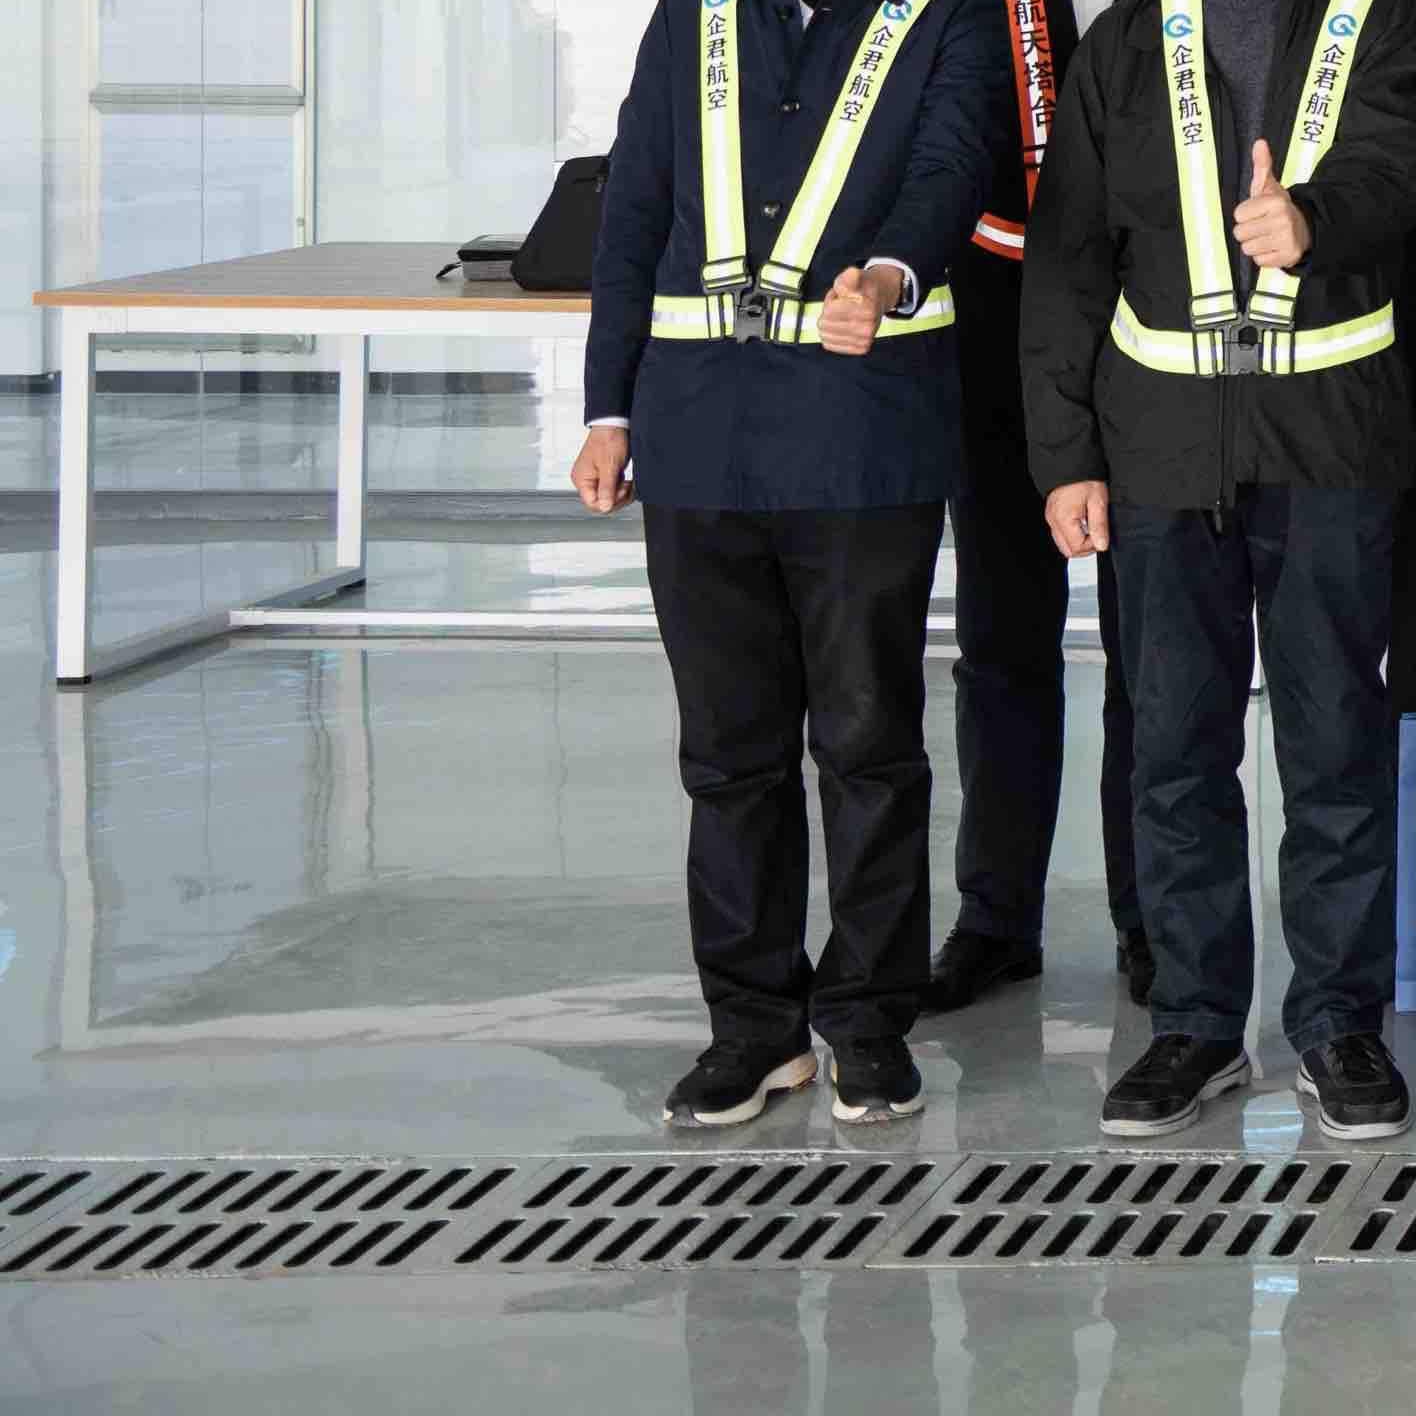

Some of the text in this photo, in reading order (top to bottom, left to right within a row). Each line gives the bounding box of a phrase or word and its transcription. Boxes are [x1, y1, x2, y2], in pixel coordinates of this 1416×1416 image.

[706, 14, 729, 111] 企君航空
[839, 25, 894, 123] 企君航空
[1171, 44, 1204, 146] 企君航空
[1300, 45, 1345, 144] 企君航空
